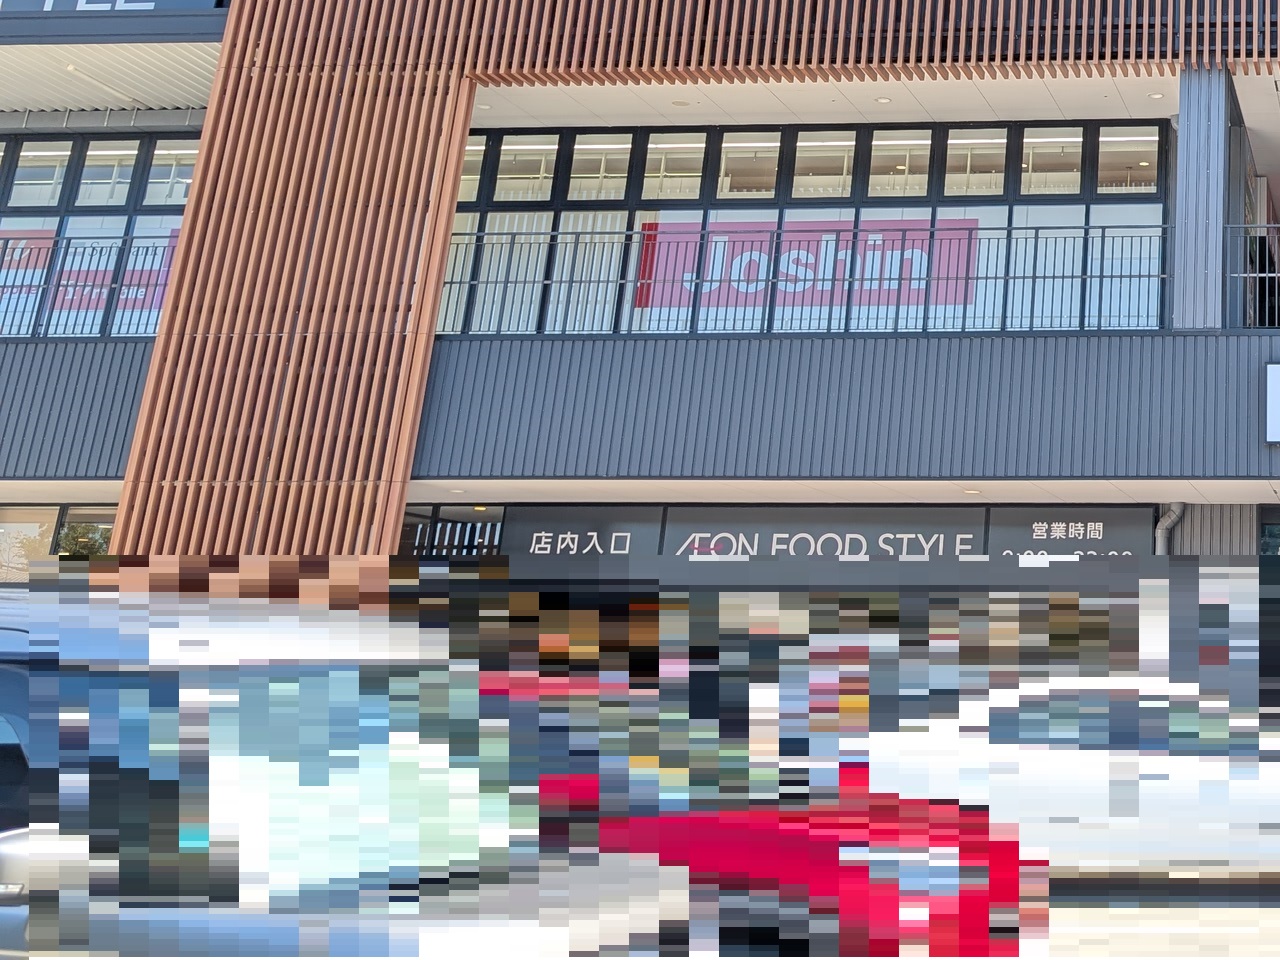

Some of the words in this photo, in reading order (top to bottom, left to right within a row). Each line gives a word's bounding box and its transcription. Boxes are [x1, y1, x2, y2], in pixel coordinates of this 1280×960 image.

[88, 242, 159, 257] Softank
[683, 234, 929, 293] Joshin
[1032, 522, 1104, 540] 営業時間
[529, 531, 632, 555] 店内入口
